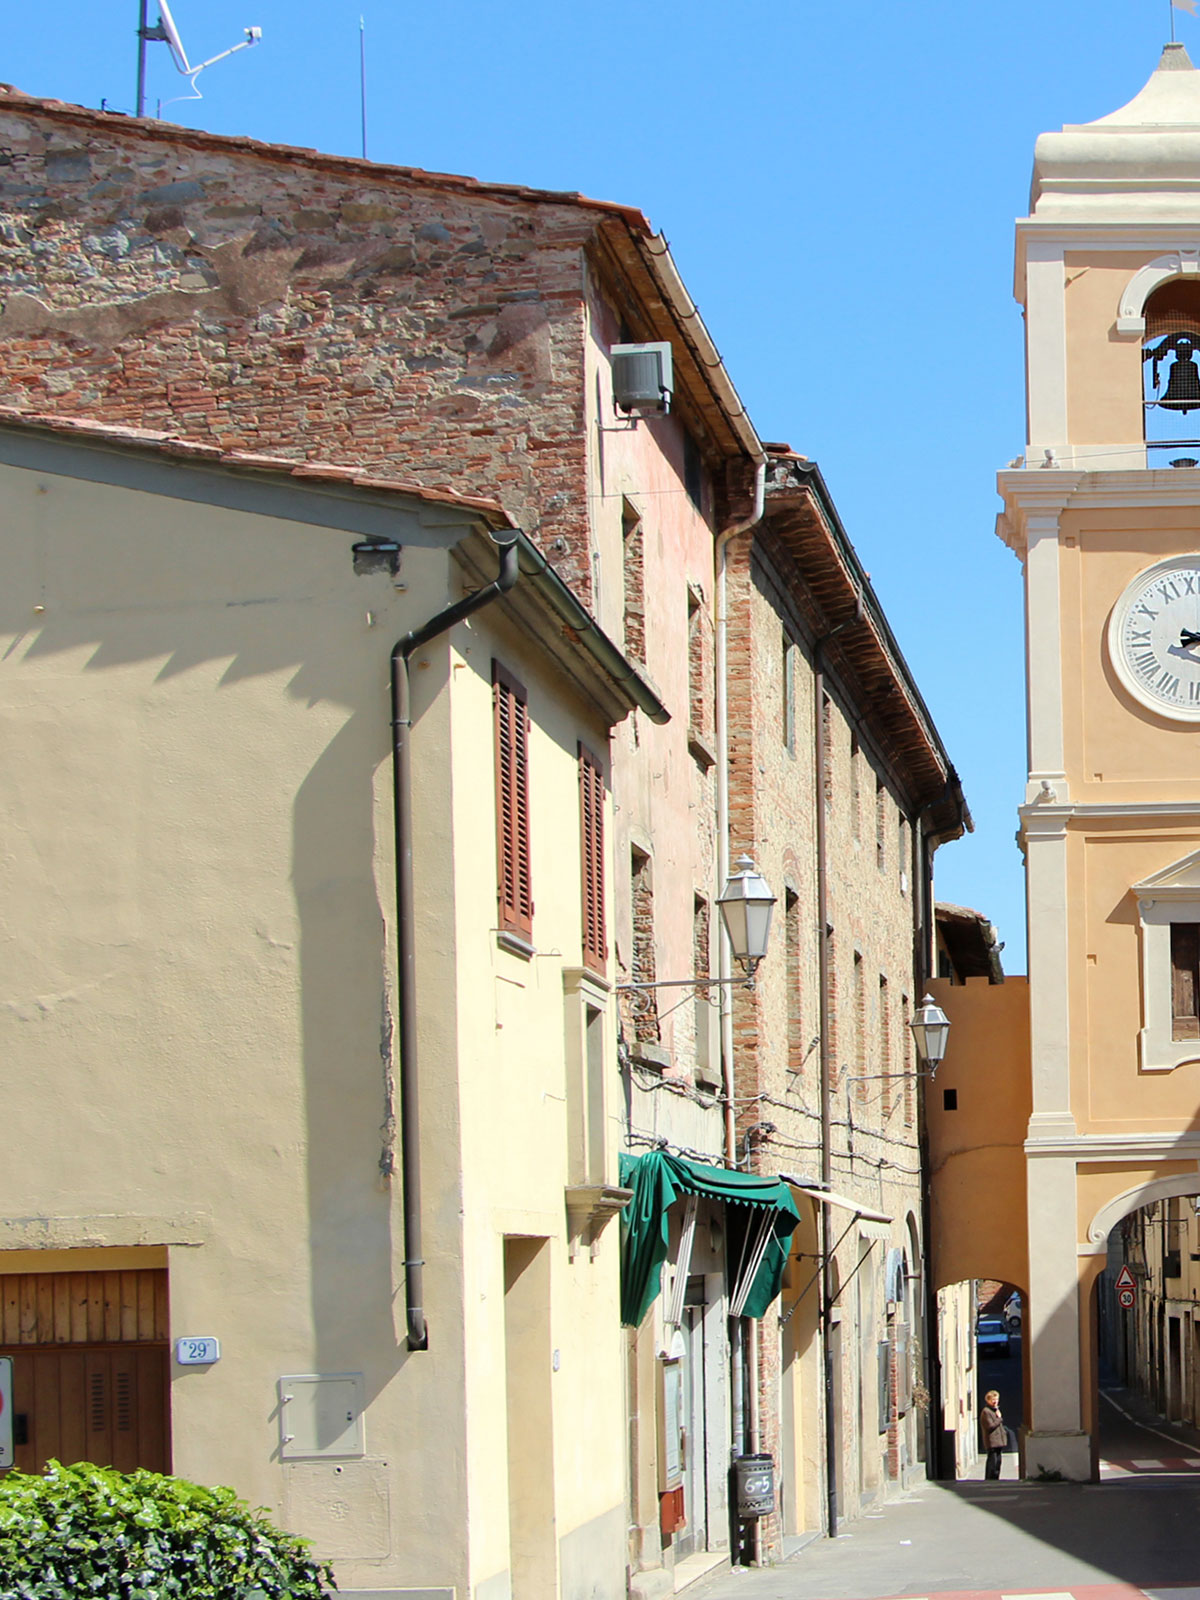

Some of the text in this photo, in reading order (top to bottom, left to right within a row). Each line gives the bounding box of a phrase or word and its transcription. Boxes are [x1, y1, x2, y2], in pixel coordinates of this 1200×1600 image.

[1157, 581, 1181, 605] XI
[1137, 604, 1159, 621] X
[1131, 630, 1152, 648] IX
[1122, 1294, 1131, 1304] 30
[188, 1341, 207, 1359] 29
